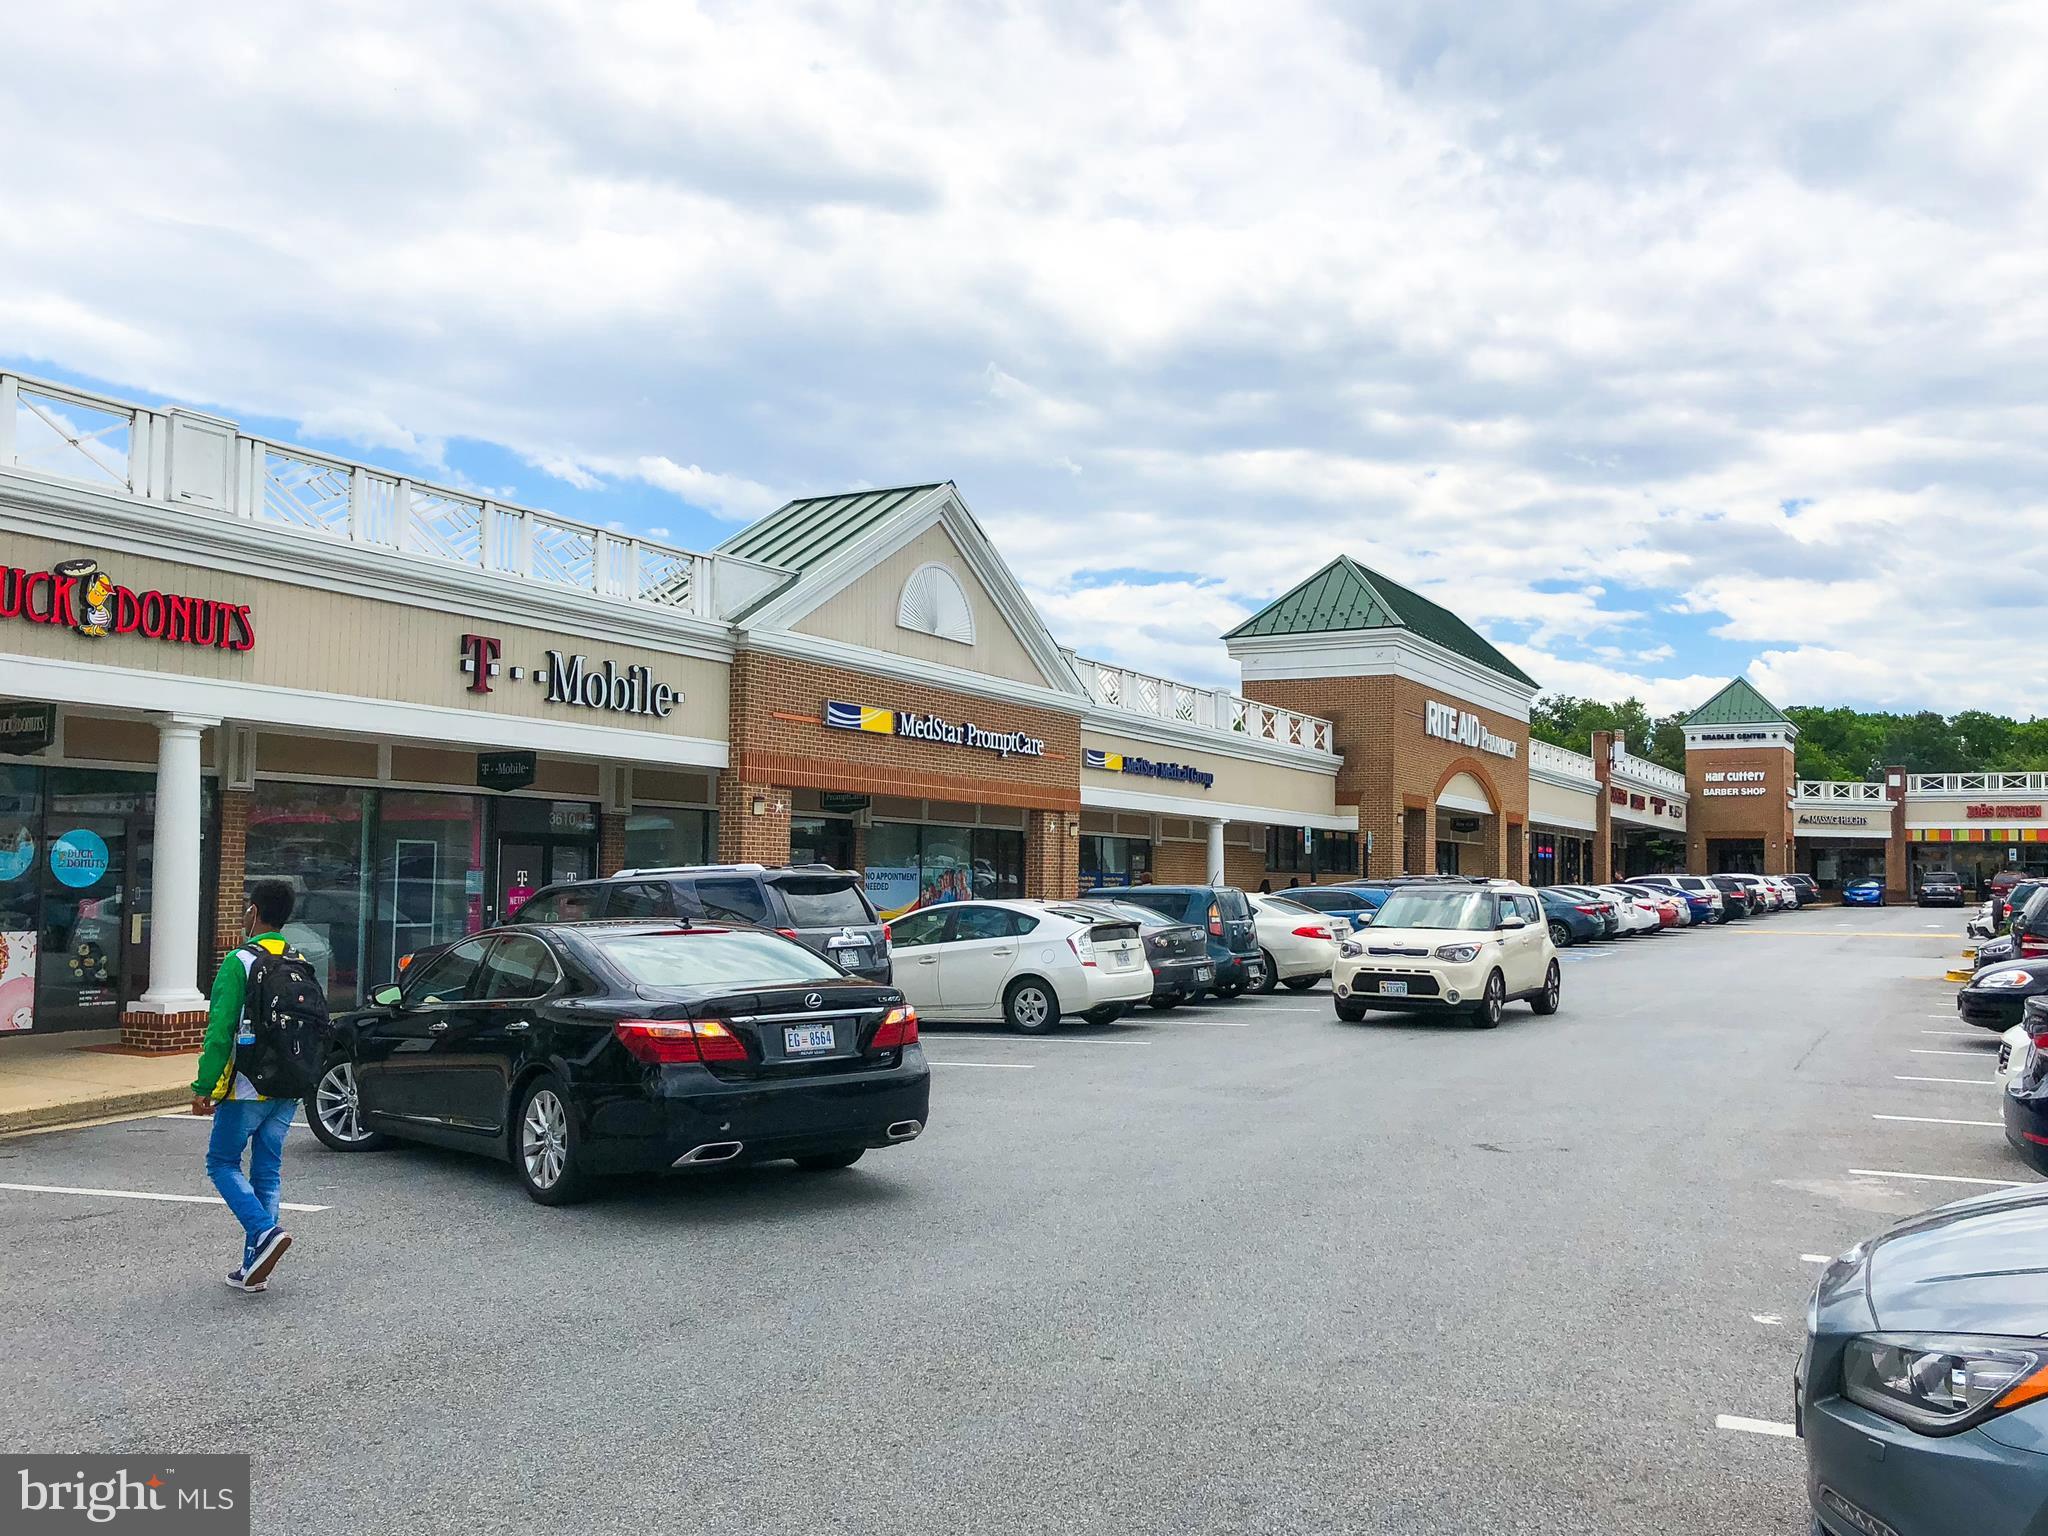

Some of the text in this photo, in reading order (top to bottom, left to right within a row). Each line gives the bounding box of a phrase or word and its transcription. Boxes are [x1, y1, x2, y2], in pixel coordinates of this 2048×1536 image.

[115, 585, 255, 651] DONUTS
[900, 712, 1045, 757] MedStar PromptCare
[1426, 700, 1457, 742] RITE
[1457, 711, 1480, 748] AID
[1125, 756, 1214, 790] MedStar Medical Group
[1705, 772, 1726, 782] Hair
[1703, 787, 1767, 796] BARBER SHOP
[865, 872, 917, 881] NO APPOINTMENT
[865, 882, 890, 891] NEEDED
